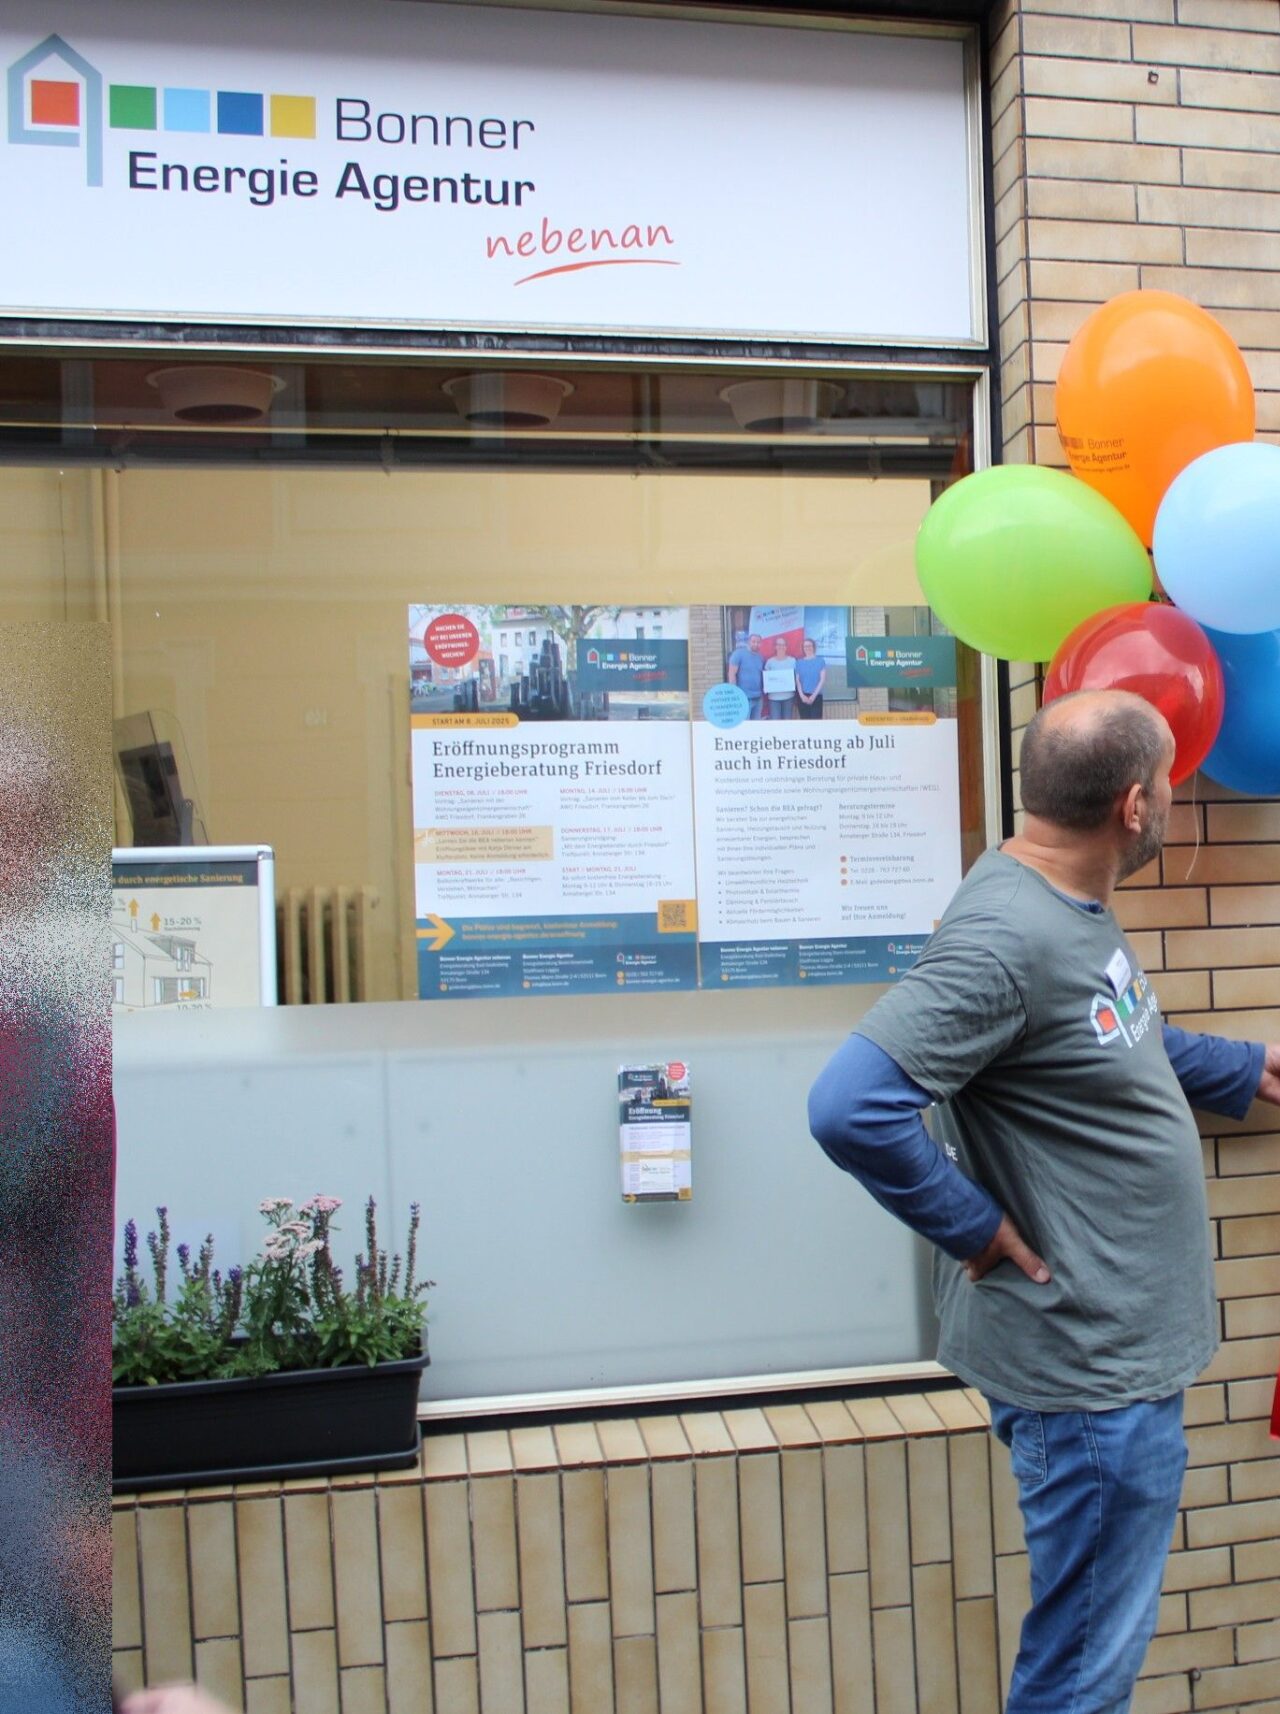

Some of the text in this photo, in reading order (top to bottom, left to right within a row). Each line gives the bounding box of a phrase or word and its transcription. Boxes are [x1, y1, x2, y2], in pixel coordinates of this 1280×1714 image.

[336, 97, 535, 151] Bonner
[128, 151, 535, 212] Energie Agentur
[486, 217, 675, 260] nebenan
[1087, 437, 1125, 450] Bonner
[629, 653, 657, 661] Bonner
[895, 650, 923, 659] Bonner
[602, 662, 658, 671] Energie Agentur
[870, 659, 924, 667] Energie Agentur
[432, 717, 453, 726] START
[454, 717, 465, 725] AM
[474, 717, 490, 725] JULI
[491, 717, 510, 725] 2025
[432, 740, 620, 759] Eröffnungsprogramm
[714, 734, 896, 753] Energieberatung ab Juli
[714, 754, 847, 771] auch in Friesdorf
[433, 760, 663, 781] Energieberatung Friesdorf
[806, 775, 836, 783] Beratung
[839, 803, 896, 811] Beratungstermine
[118, 872, 244, 885] durch energetische Sanierung
